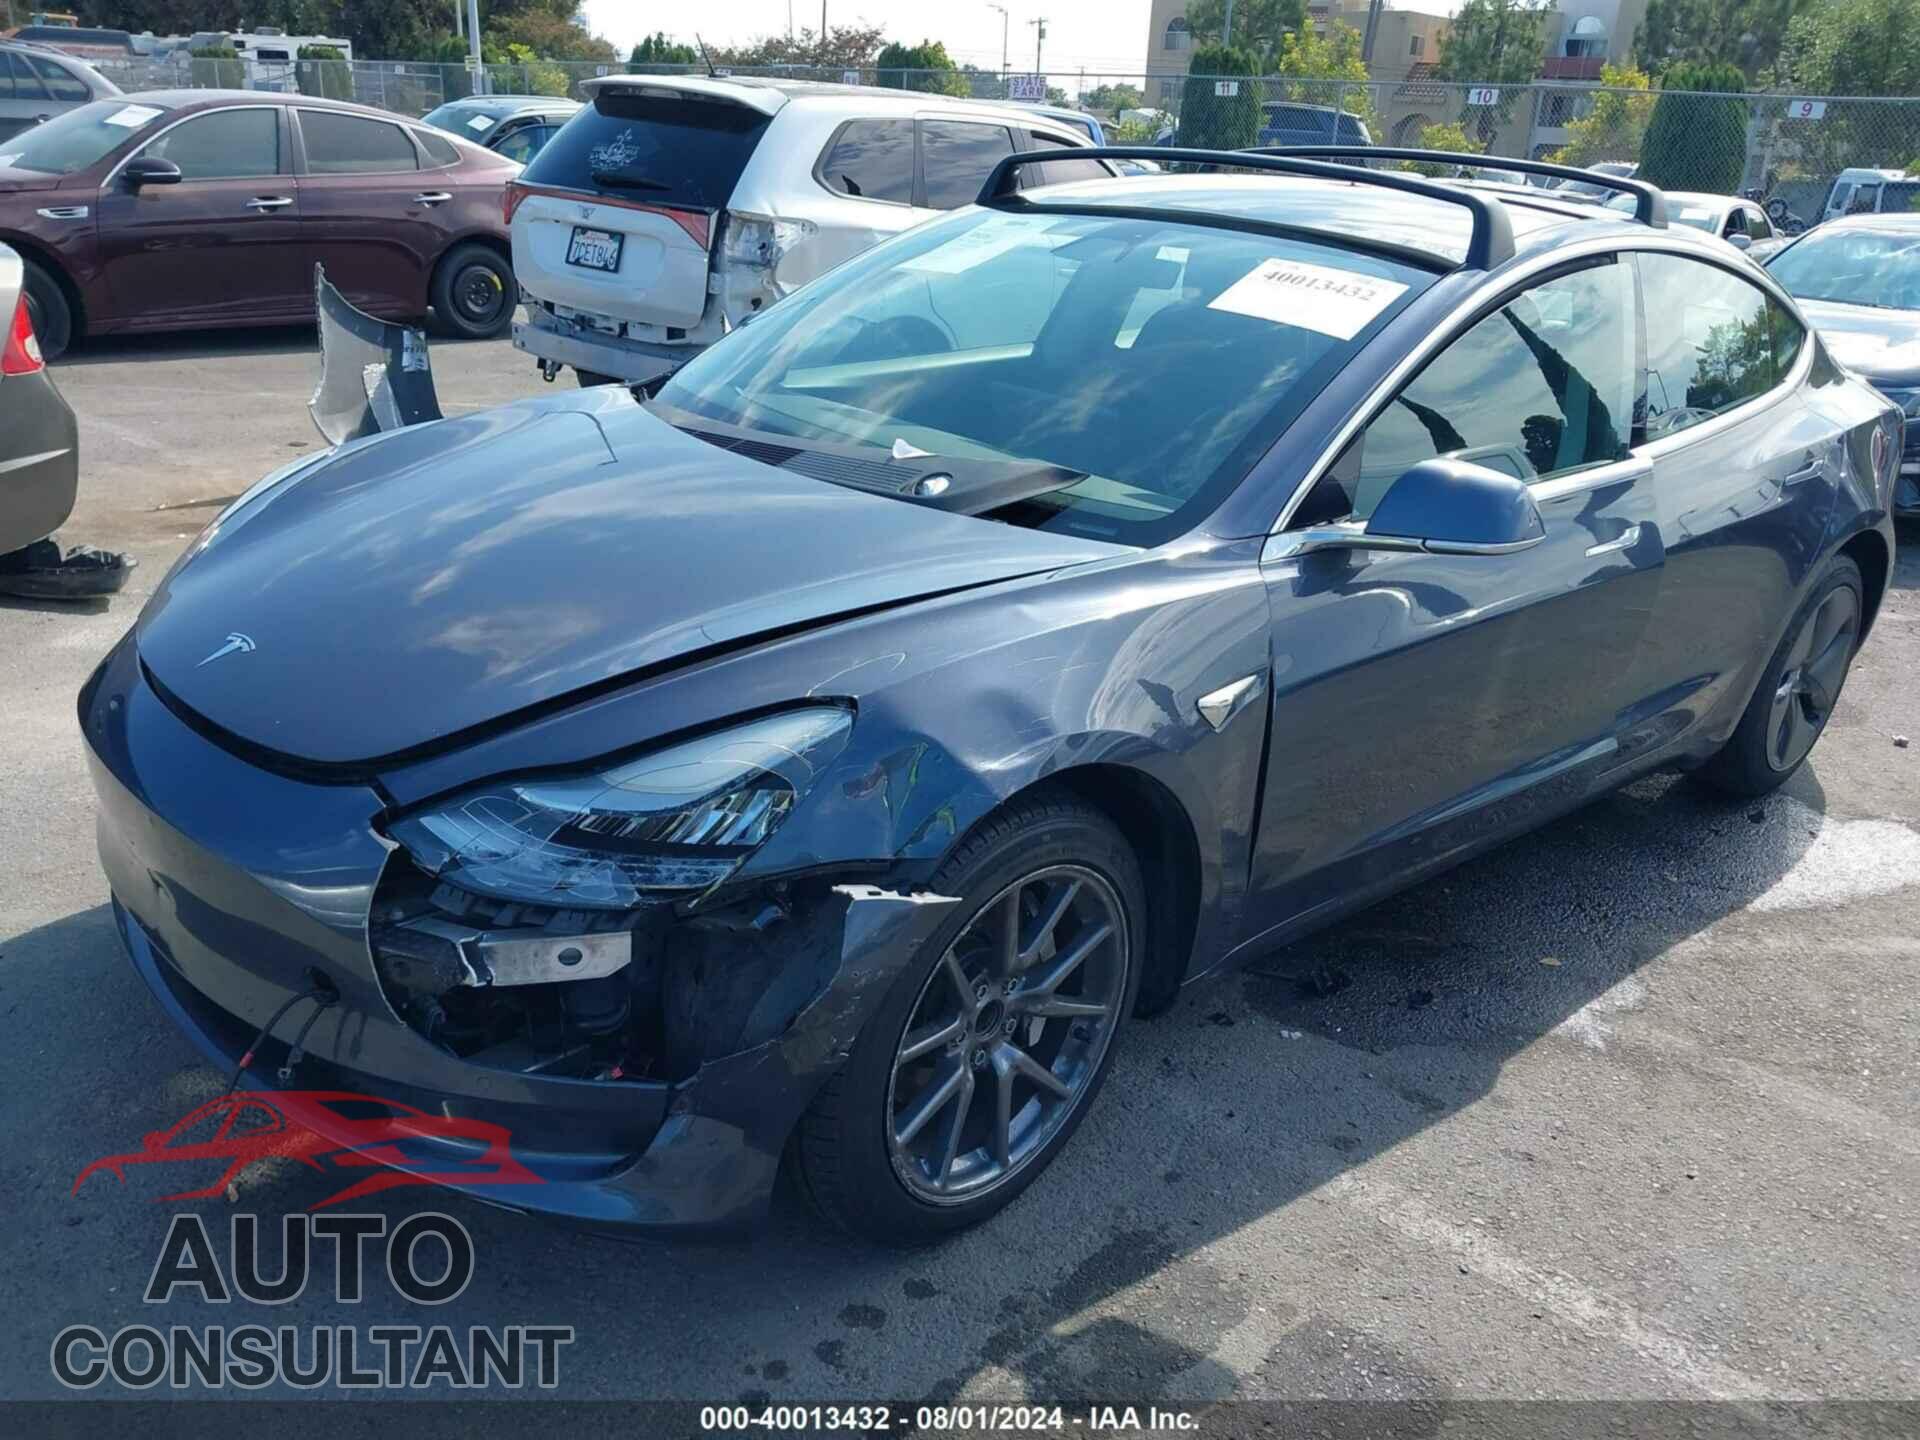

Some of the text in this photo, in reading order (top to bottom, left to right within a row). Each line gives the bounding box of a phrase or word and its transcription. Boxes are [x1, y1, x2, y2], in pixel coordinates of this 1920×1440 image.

[1012, 76, 1046, 86] STATE
[1013, 86, 1043, 97] FARM
[1220, 83, 1230, 95] 11
[1475, 90, 1492, 104] 10
[1801, 102, 1813, 117] 9
[1263, 270, 1377, 301] 40013432
